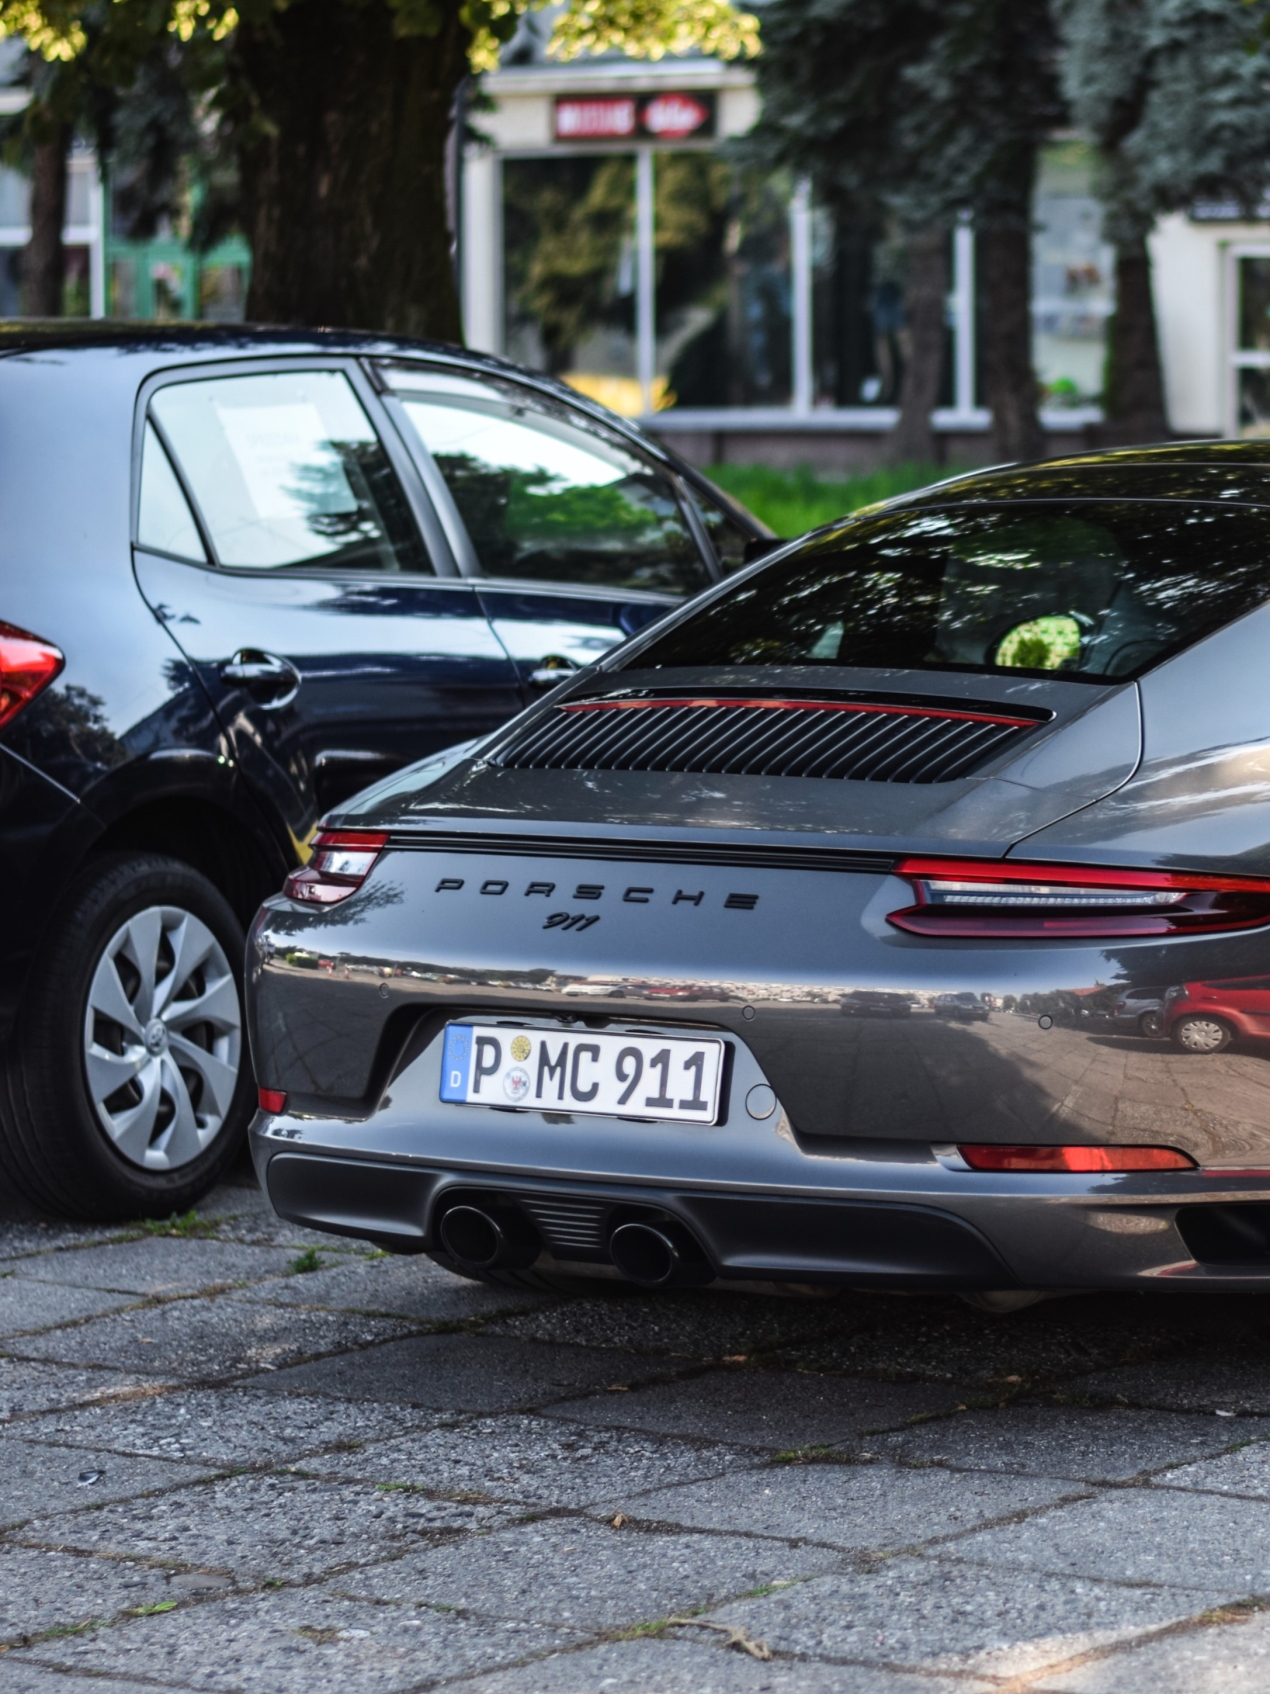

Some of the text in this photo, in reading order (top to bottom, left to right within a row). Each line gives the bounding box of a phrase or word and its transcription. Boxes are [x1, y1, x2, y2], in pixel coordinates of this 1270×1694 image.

[435, 878, 760, 910] PORSCHE
[542, 911, 600, 932] 911
[450, 1070, 461, 1088] D
[473, 1036, 709, 1111] P MC 911
